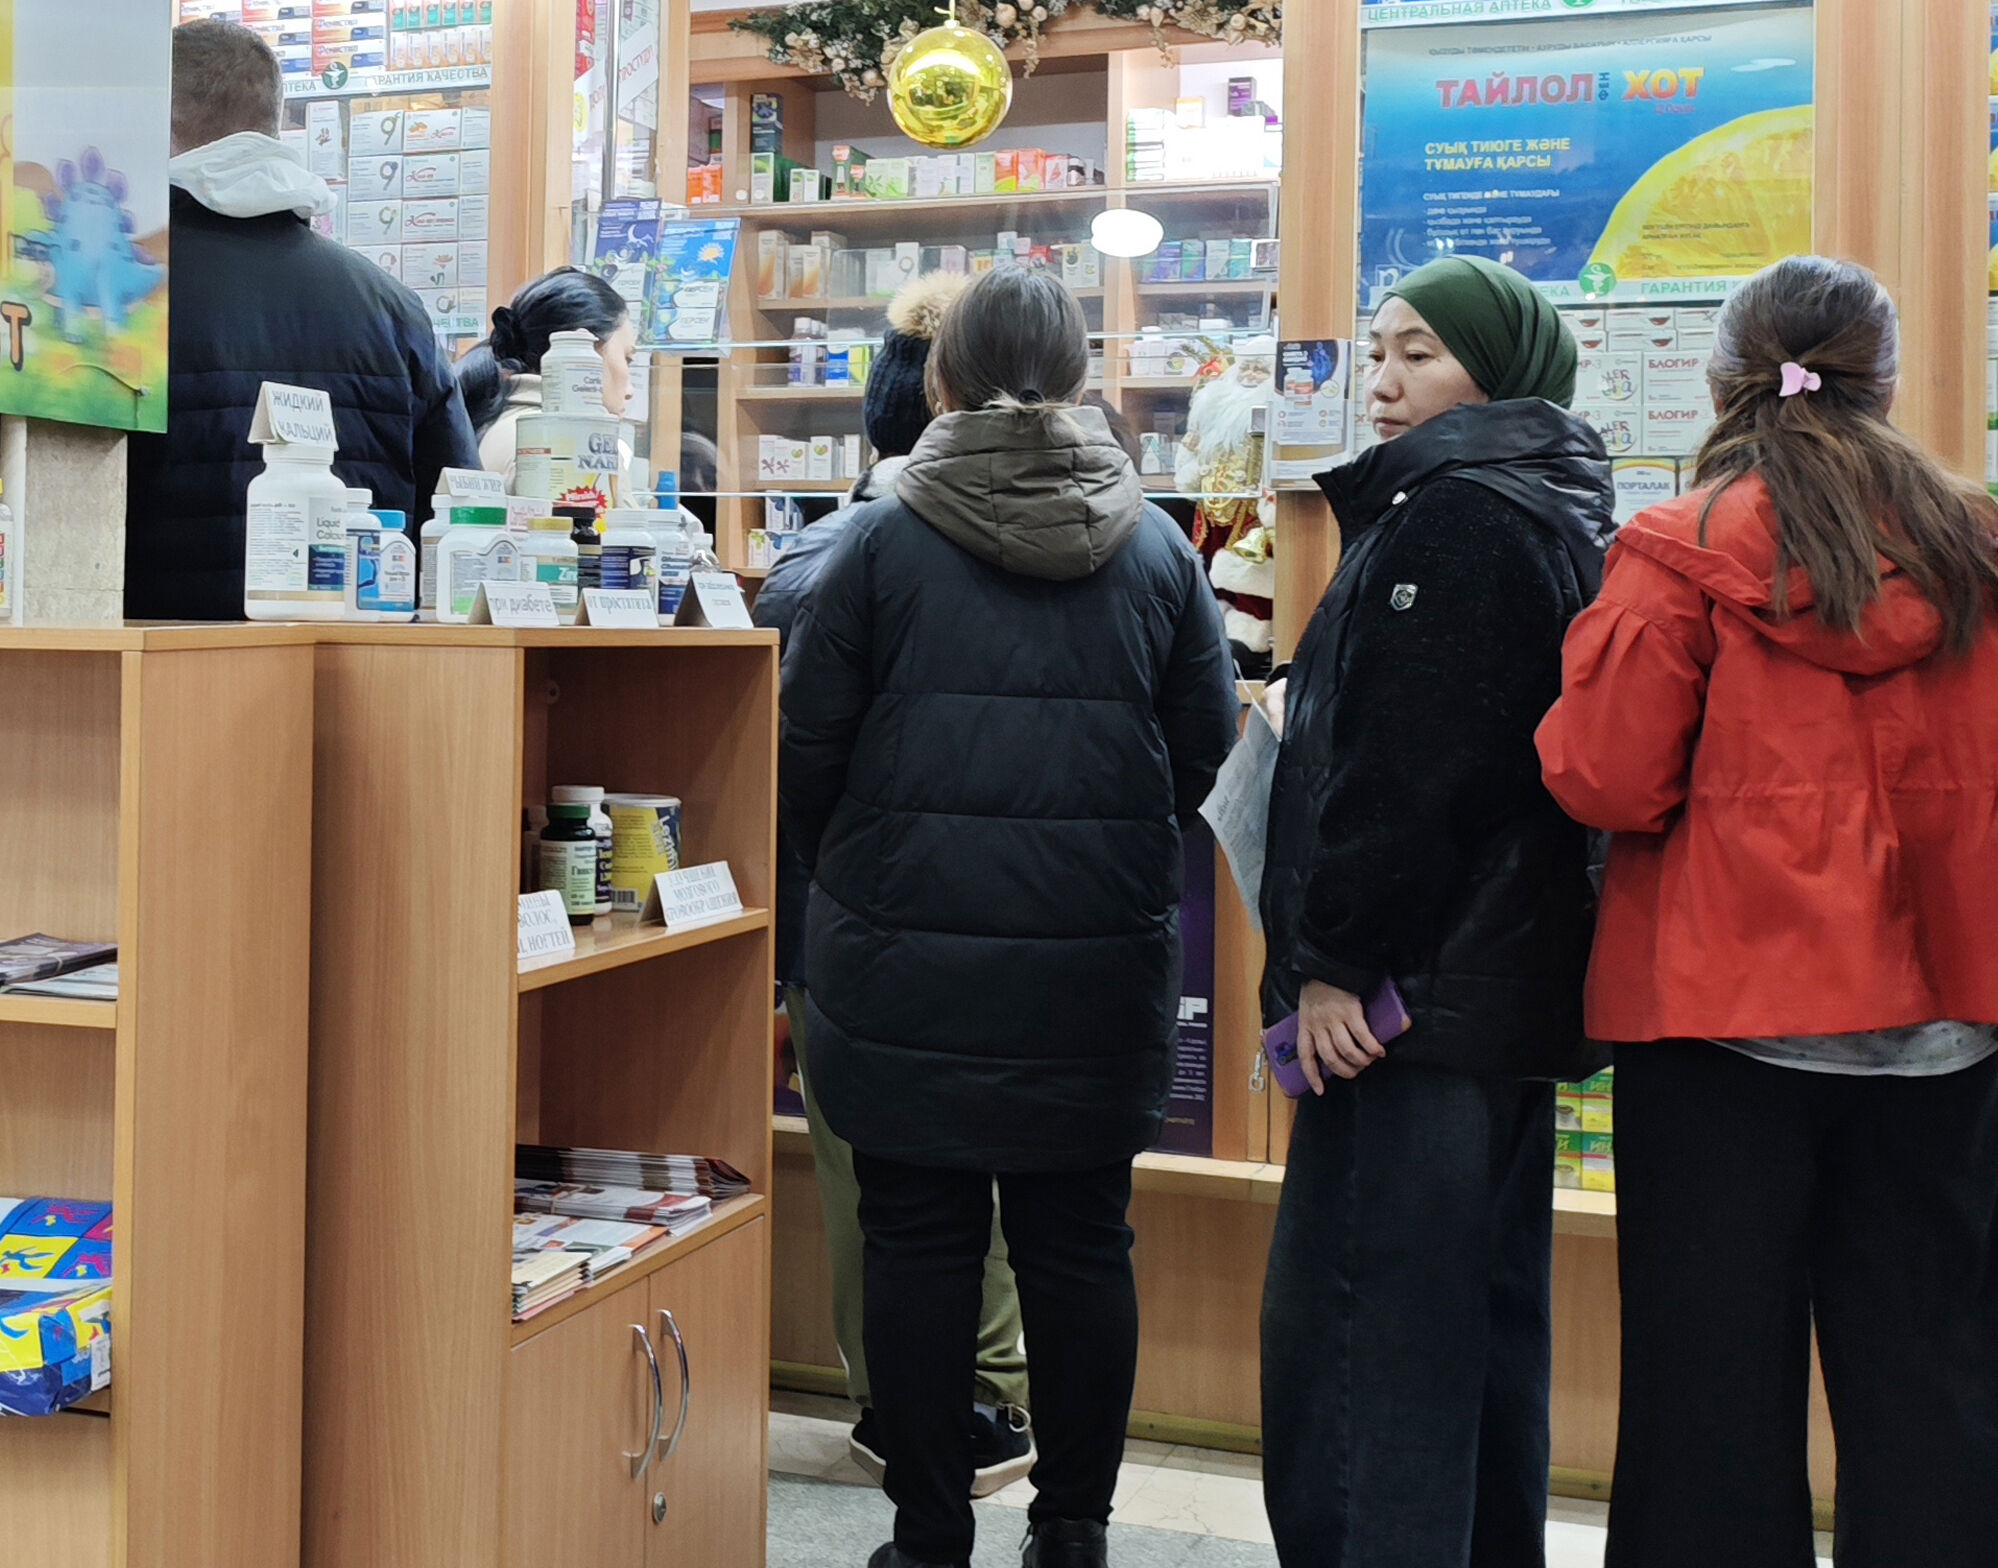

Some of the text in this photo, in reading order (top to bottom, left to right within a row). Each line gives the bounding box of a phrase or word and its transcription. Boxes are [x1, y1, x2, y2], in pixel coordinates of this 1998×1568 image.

[1367, 3, 1484, 23] ЦЕНТРАЛЬНАЯ
[282, 80, 316, 93] ПТЕКА
[425, 66, 489, 82] КАЧЕСТВА
[1436, 71, 1594, 109] ТАЙЛОЛ
[1623, 67, 1705, 101] ХОТ
[1425, 137, 1571, 155] СУЫҚ ТИЮГЕ ЖӘНЕ
[1497, 155, 1551, 170] ҚАРСЫ
[1641, 281, 1727, 295] ГАРАНТИЯ
[272, 390, 324, 412] ЖИДКИЙ
[276, 420, 334, 444] КАЛЬЦИЙ
